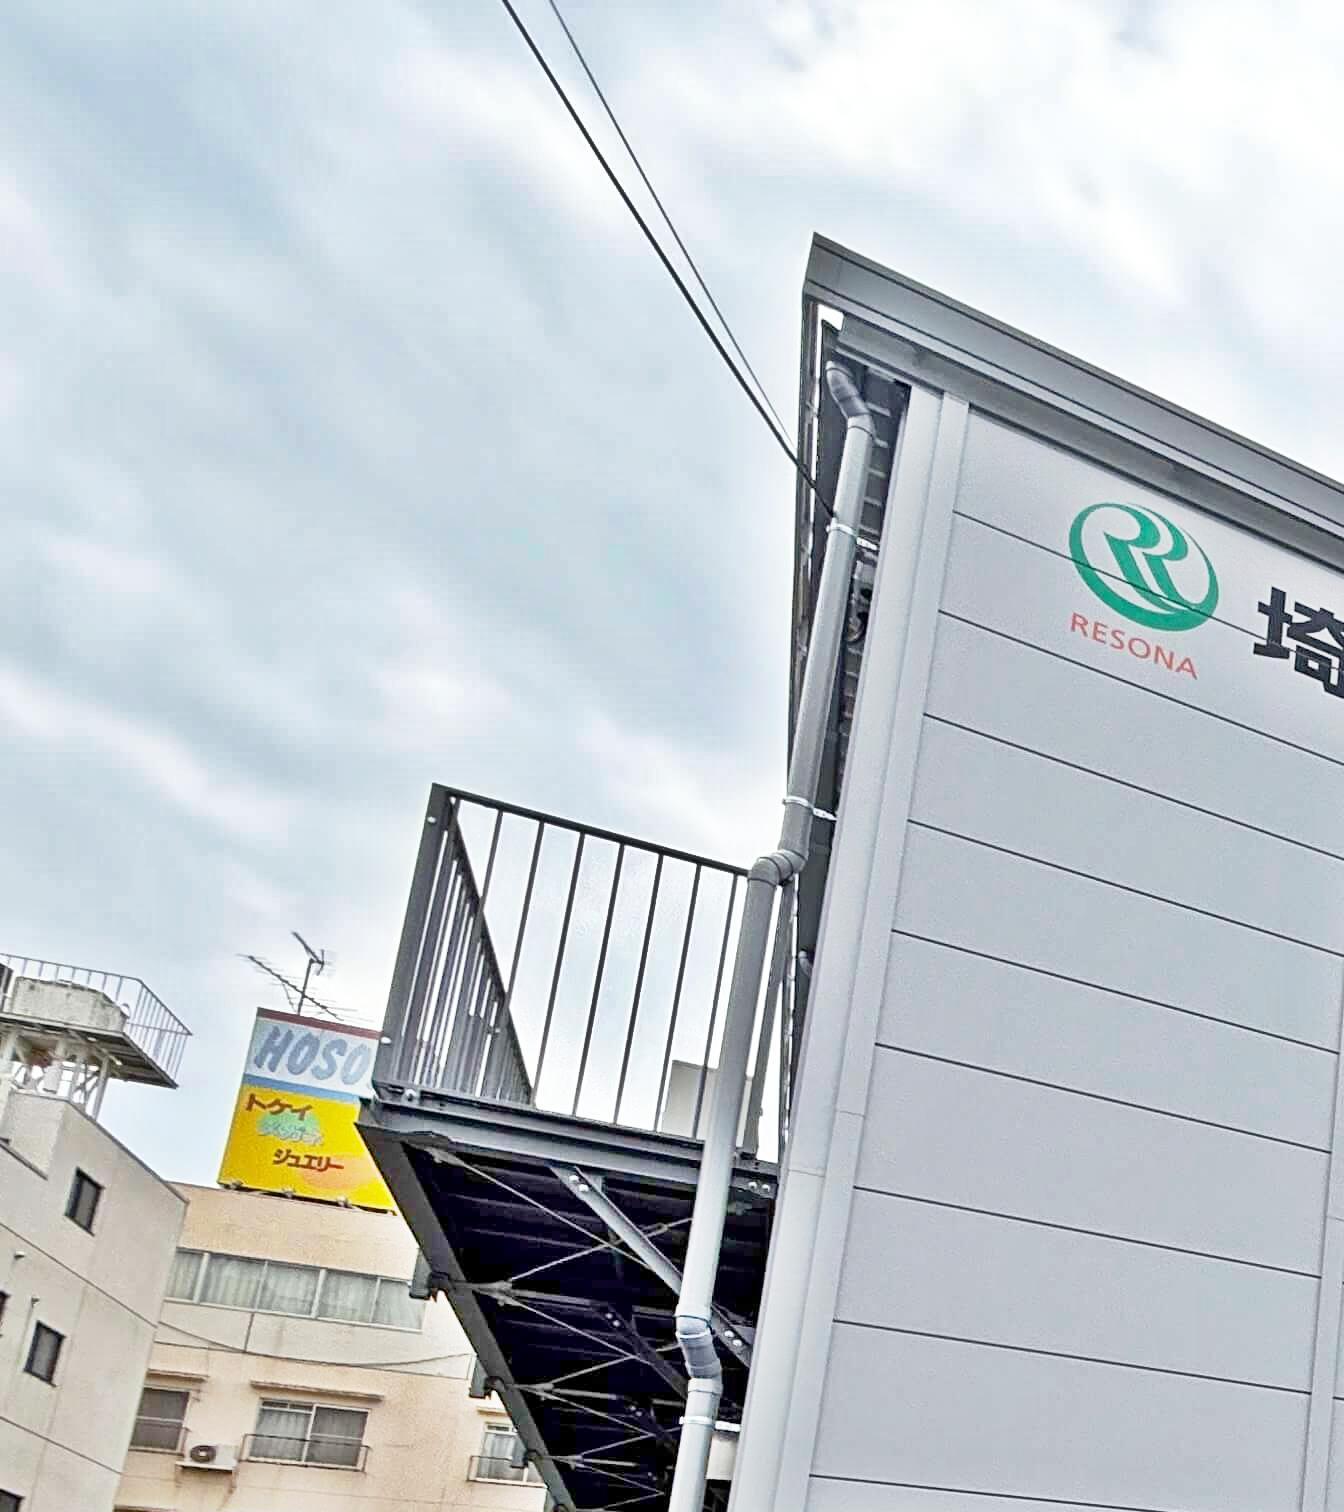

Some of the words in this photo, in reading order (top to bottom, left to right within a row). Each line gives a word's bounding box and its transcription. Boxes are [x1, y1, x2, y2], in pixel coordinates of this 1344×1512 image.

[1070, 611, 1198, 680] RESONA
[246, 1093, 313, 1121] トケイ
[272, 1148, 344, 1172] ジュエリー
